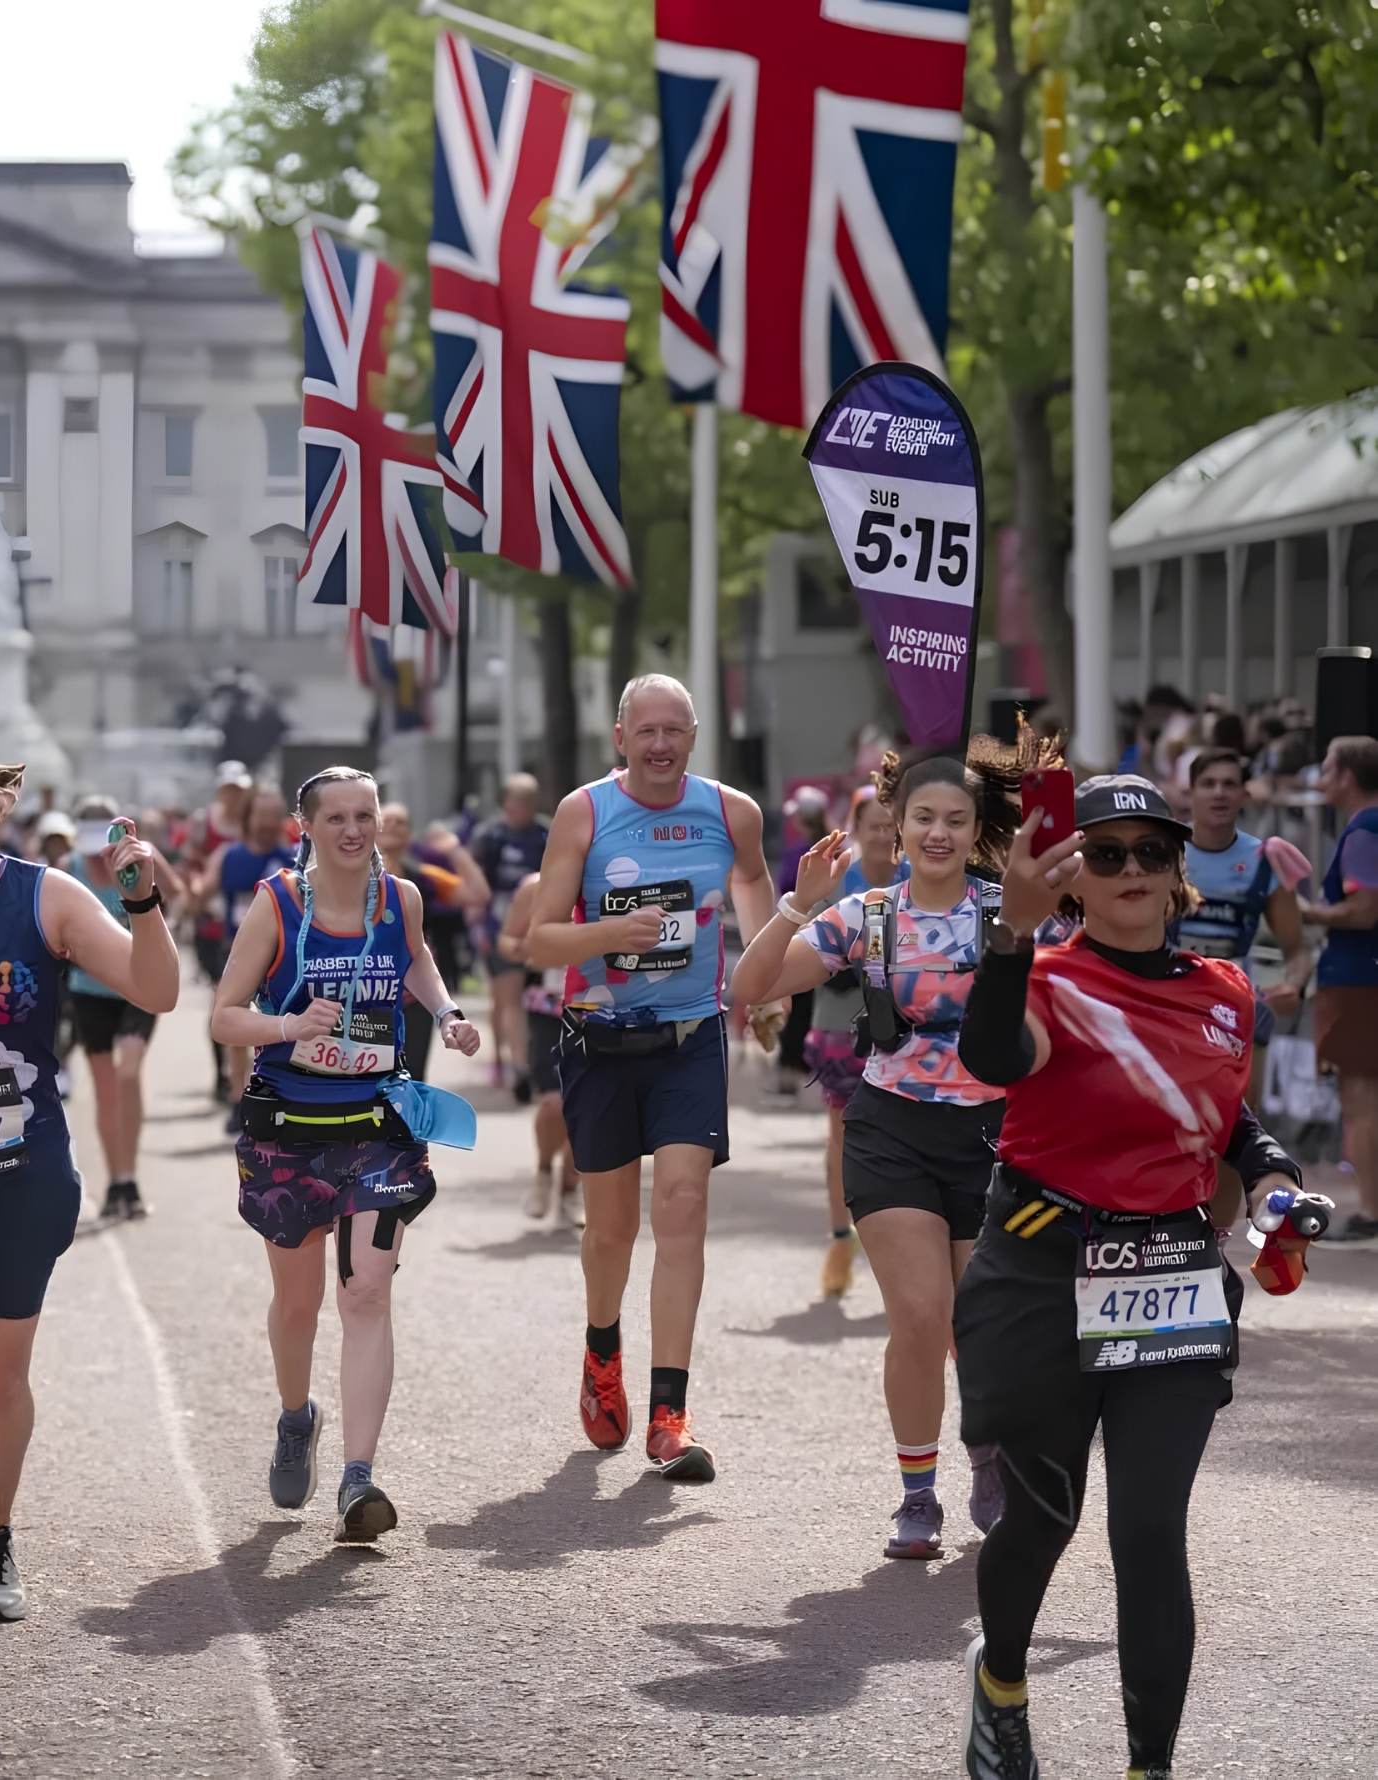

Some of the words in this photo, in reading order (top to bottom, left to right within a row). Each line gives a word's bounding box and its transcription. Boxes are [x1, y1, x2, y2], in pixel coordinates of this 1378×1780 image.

[890, 415, 941, 431] LONDON
[887, 427, 956, 446] MARATHON
[869, 489, 900, 508] SUB
[854, 509, 971, 587] 5:15
[889, 625, 967, 655] INSPIRING
[886, 647, 961, 672] ACTIVITY
[1099, 1284, 1200, 1323] 47877
